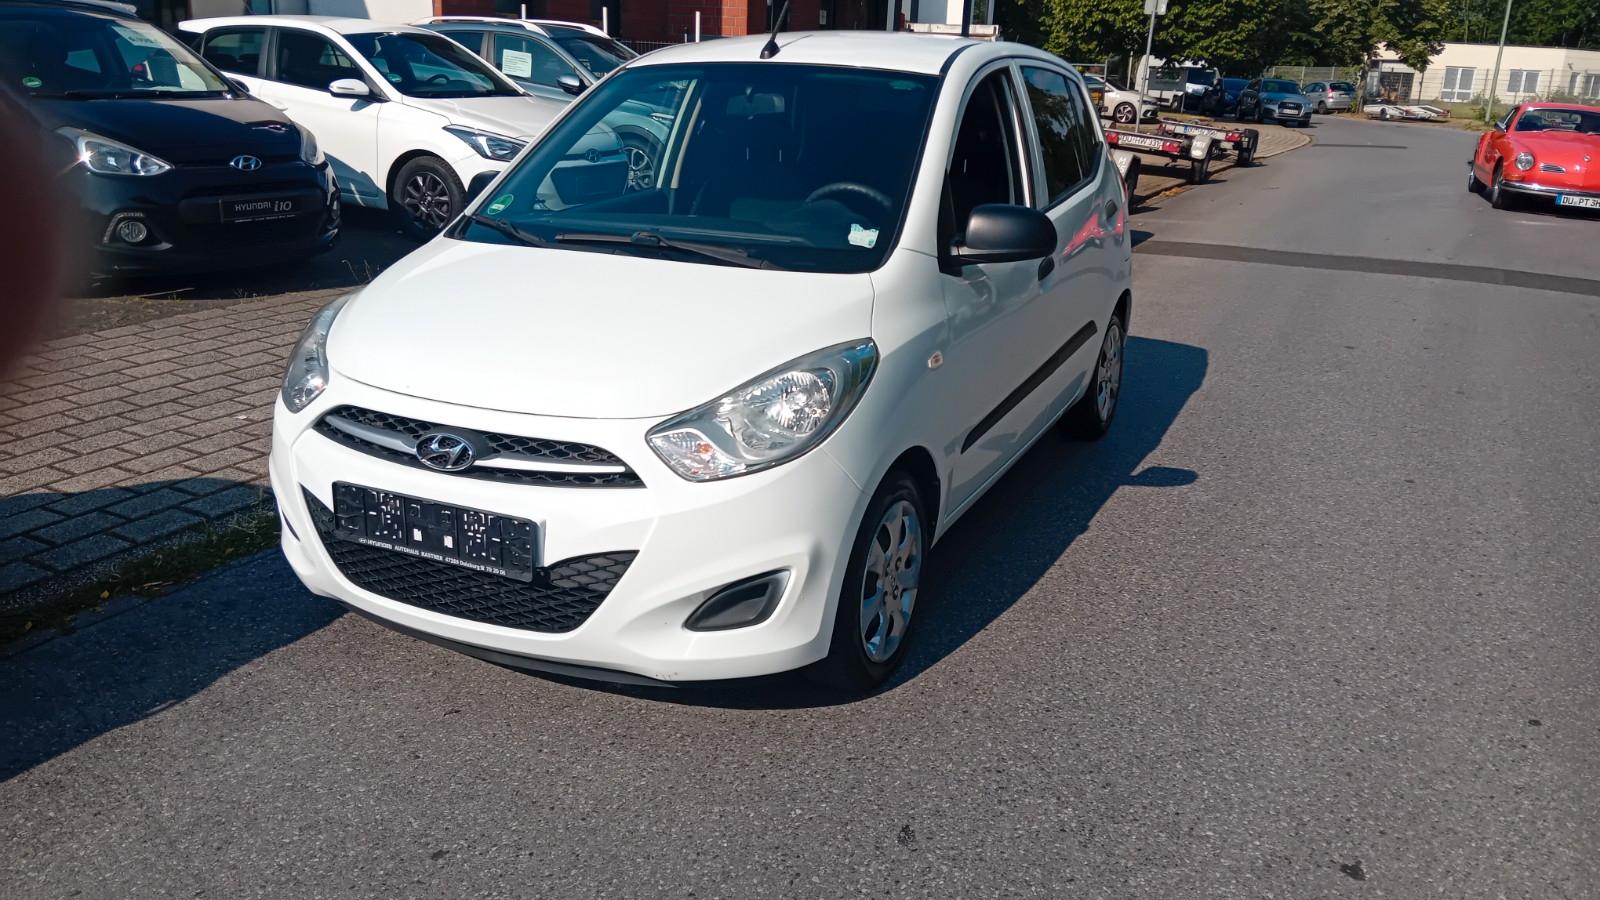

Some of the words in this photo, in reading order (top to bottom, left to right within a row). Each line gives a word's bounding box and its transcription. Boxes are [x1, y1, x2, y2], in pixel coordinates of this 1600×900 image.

[234, 201, 271, 212] HYUNDAI
[274, 200, 292, 212] i10
[1562, 196, 1574, 205] DU
[367, 539, 393, 550] HYUNDAI
